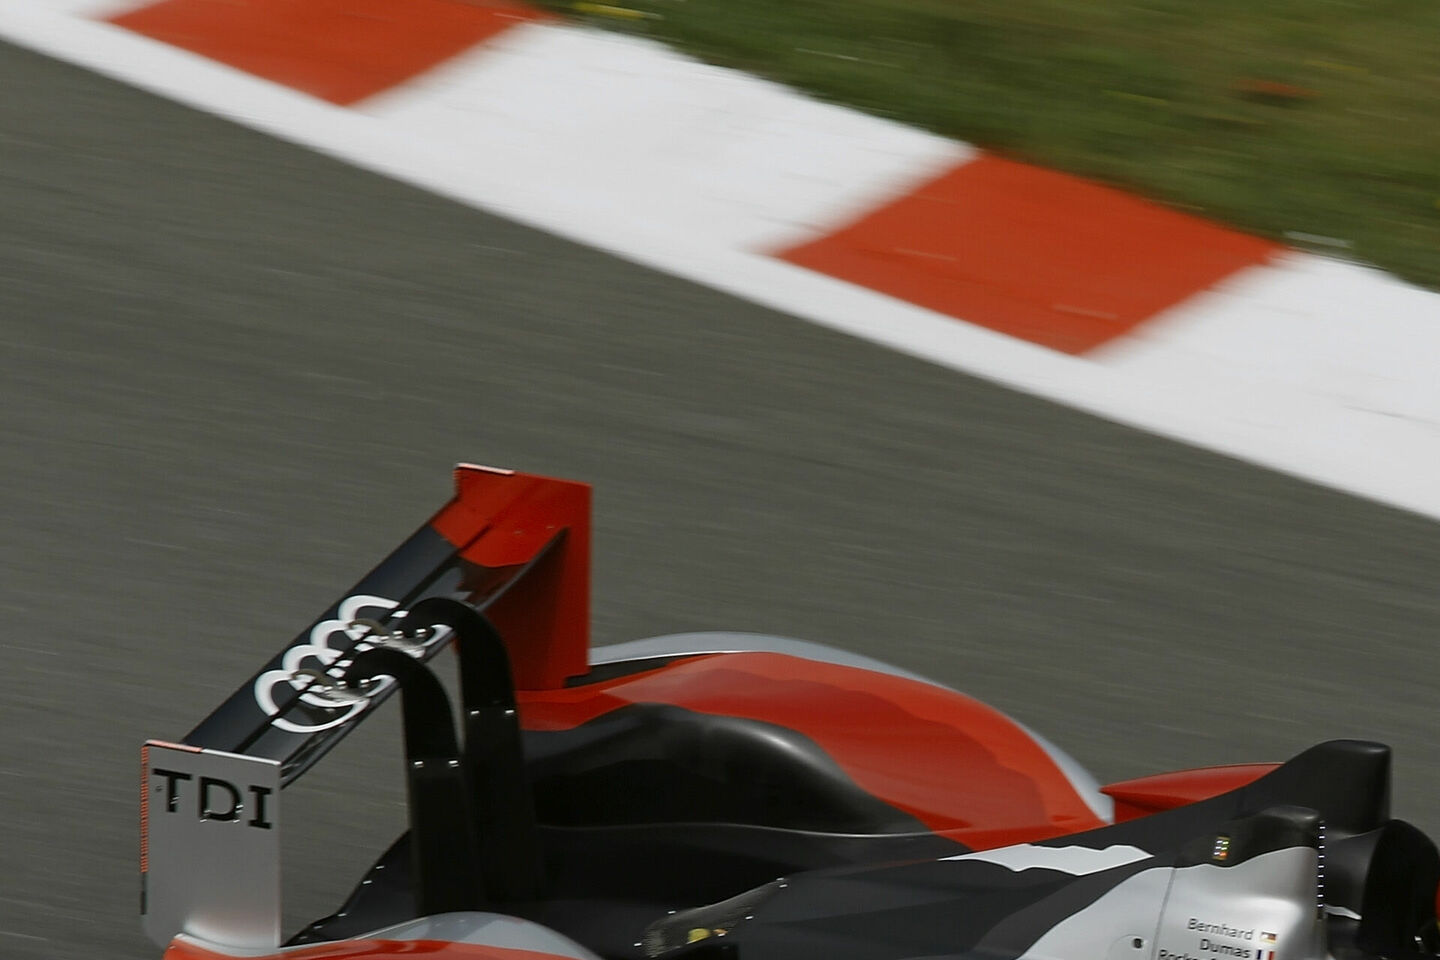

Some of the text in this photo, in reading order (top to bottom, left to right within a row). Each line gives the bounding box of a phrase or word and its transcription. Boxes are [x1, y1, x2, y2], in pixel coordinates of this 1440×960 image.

[152, 768, 272, 829] TDI
[1187, 918, 1254, 941] Bernhard
[1200, 938, 1250, 959] Dumas
